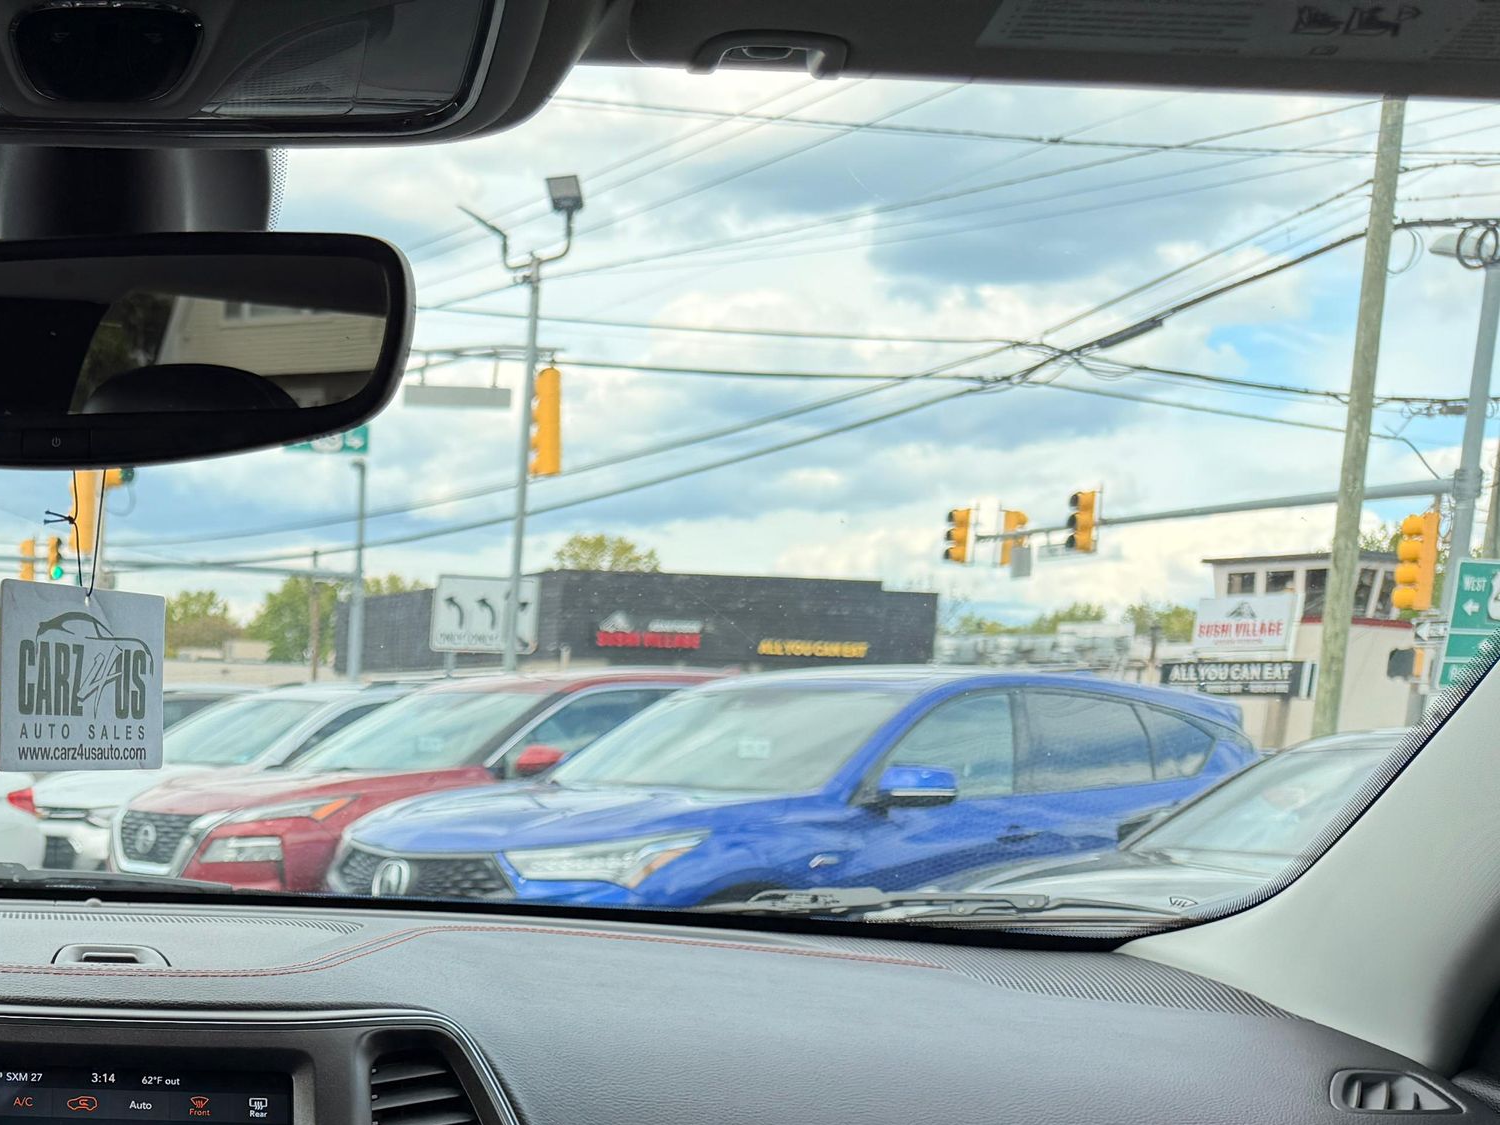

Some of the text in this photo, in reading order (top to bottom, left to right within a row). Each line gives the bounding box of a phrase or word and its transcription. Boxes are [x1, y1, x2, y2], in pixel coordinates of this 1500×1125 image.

[1463, 575, 1487, 592] WEST
[1235, 622, 1284, 637] VILLAGE
[1169, 663, 1293, 681] ALL YOU CAN EAT
[19, 723, 145, 740] AUTO SALES
[18, 743, 147, 761] www.carz4usauto.com
[6, 1072, 43, 1082] SXM 27
[91, 1073, 116, 1083] 3:14
[141, 1075, 180, 1086] 62°F out
[13, 1097, 33, 1107] A/C
[129, 1100, 152, 1111] Auto
[189, 1108, 210, 1117] Front
[249, 1109, 268, 1119] Rear
